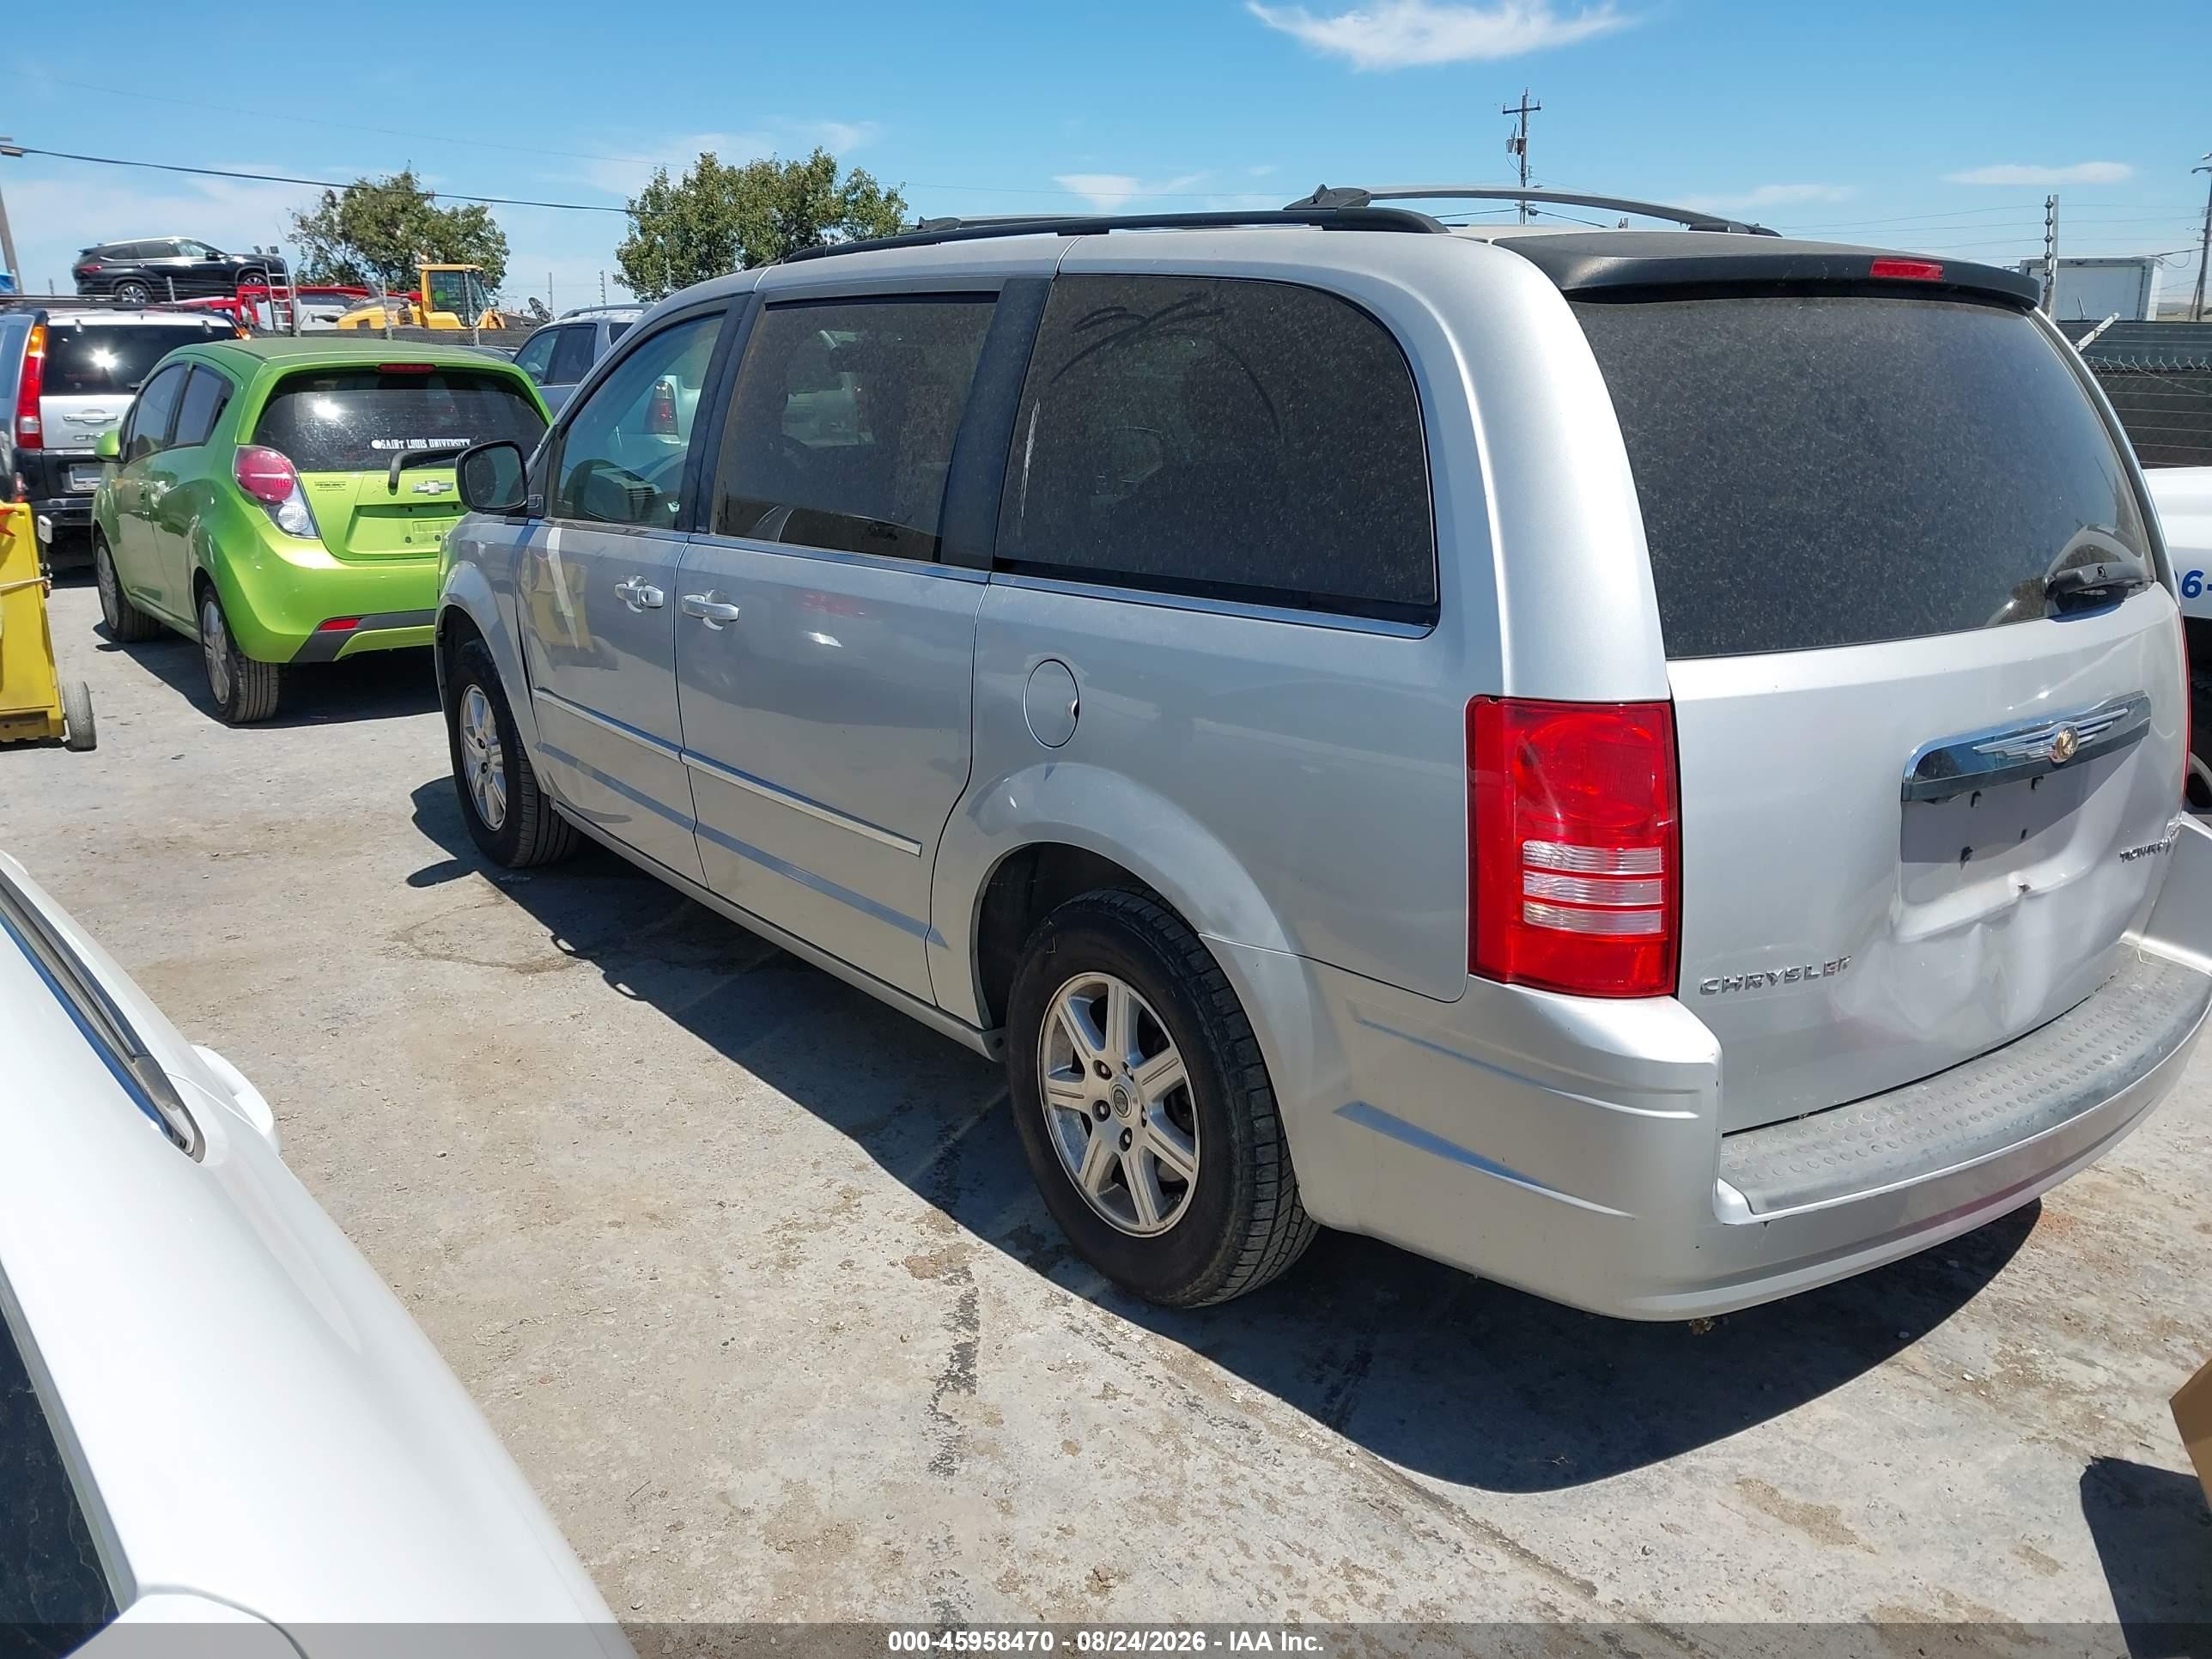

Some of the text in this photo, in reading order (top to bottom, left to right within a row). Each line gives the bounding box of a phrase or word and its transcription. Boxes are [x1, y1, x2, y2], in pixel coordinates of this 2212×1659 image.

[381, 439, 471, 449] SAINT LOUIS UNIVERSITY
